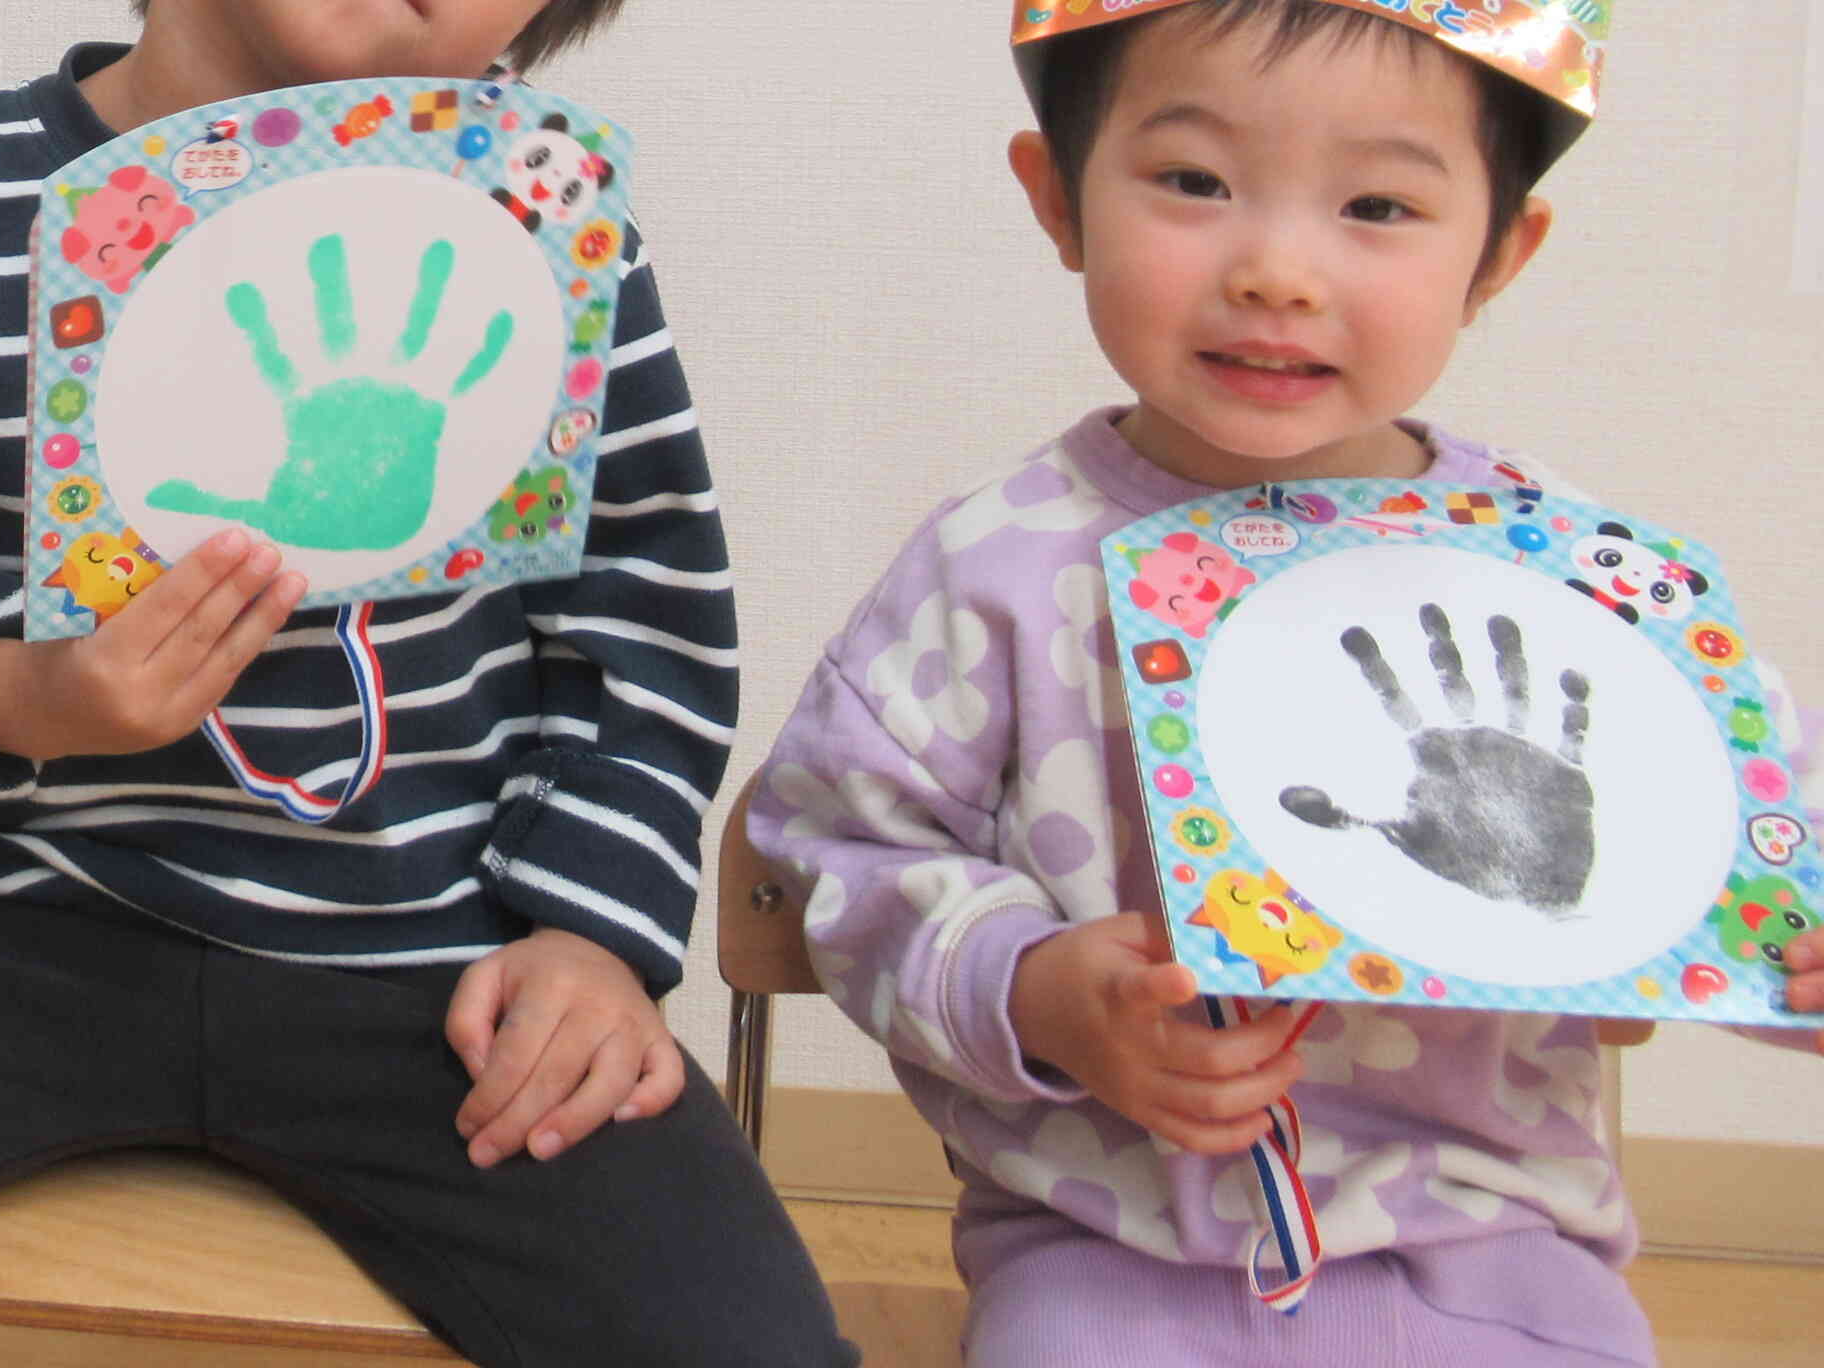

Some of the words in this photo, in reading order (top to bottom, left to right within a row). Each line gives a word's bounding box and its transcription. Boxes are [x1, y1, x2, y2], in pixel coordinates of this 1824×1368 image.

[182, 147, 240, 162] てがたを
[1232, 522, 1286, 533] てがたを
